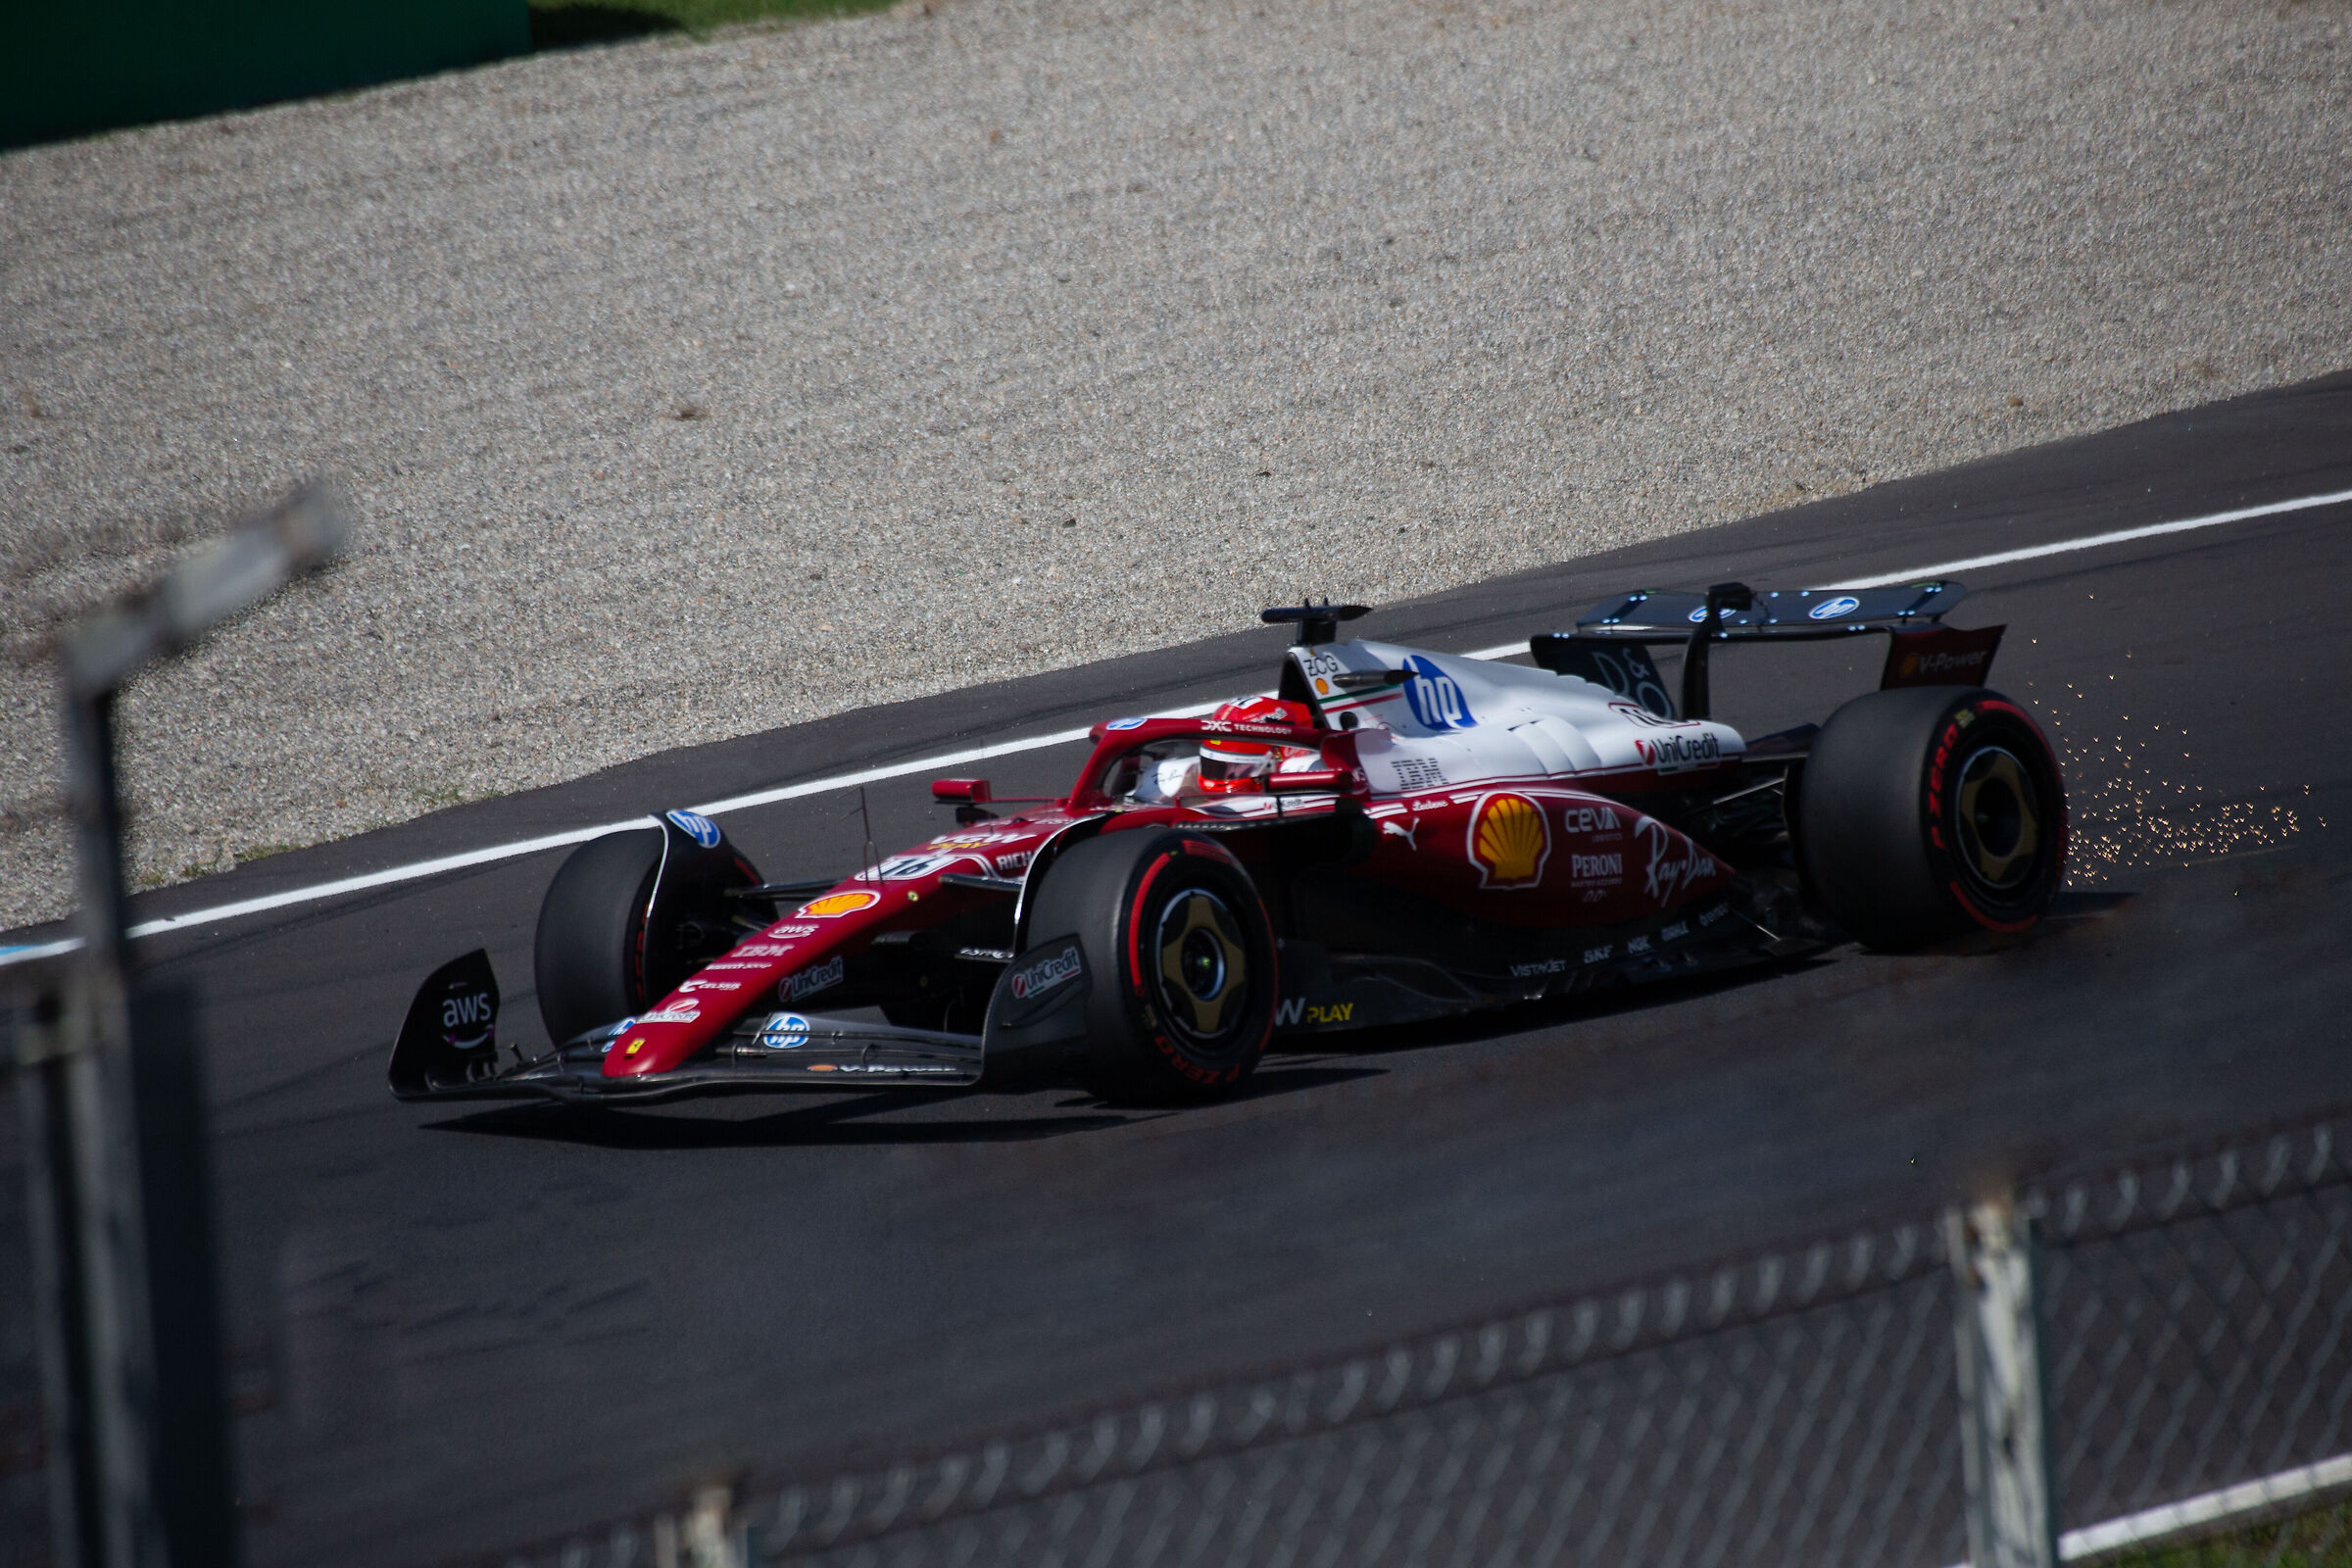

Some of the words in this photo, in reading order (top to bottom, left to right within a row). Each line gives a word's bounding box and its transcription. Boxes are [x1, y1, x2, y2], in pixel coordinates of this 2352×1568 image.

[1303, 655, 1339, 677] ZCG
[1404, 655, 1477, 732] hp
[1233, 723, 1293, 735] TECHNOLOGY
[1651, 734, 1721, 764] UniCredit
[1391, 758, 1448, 790] IBM
[1571, 854, 1623, 878] PERONI
[791, 956, 844, 997] UniCredit
[1025, 948, 1079, 990] UniCredit
[443, 992, 491, 1028] aws
[1307, 1003, 1354, 1024] PLAY
[764, 1014, 809, 1049] hp
